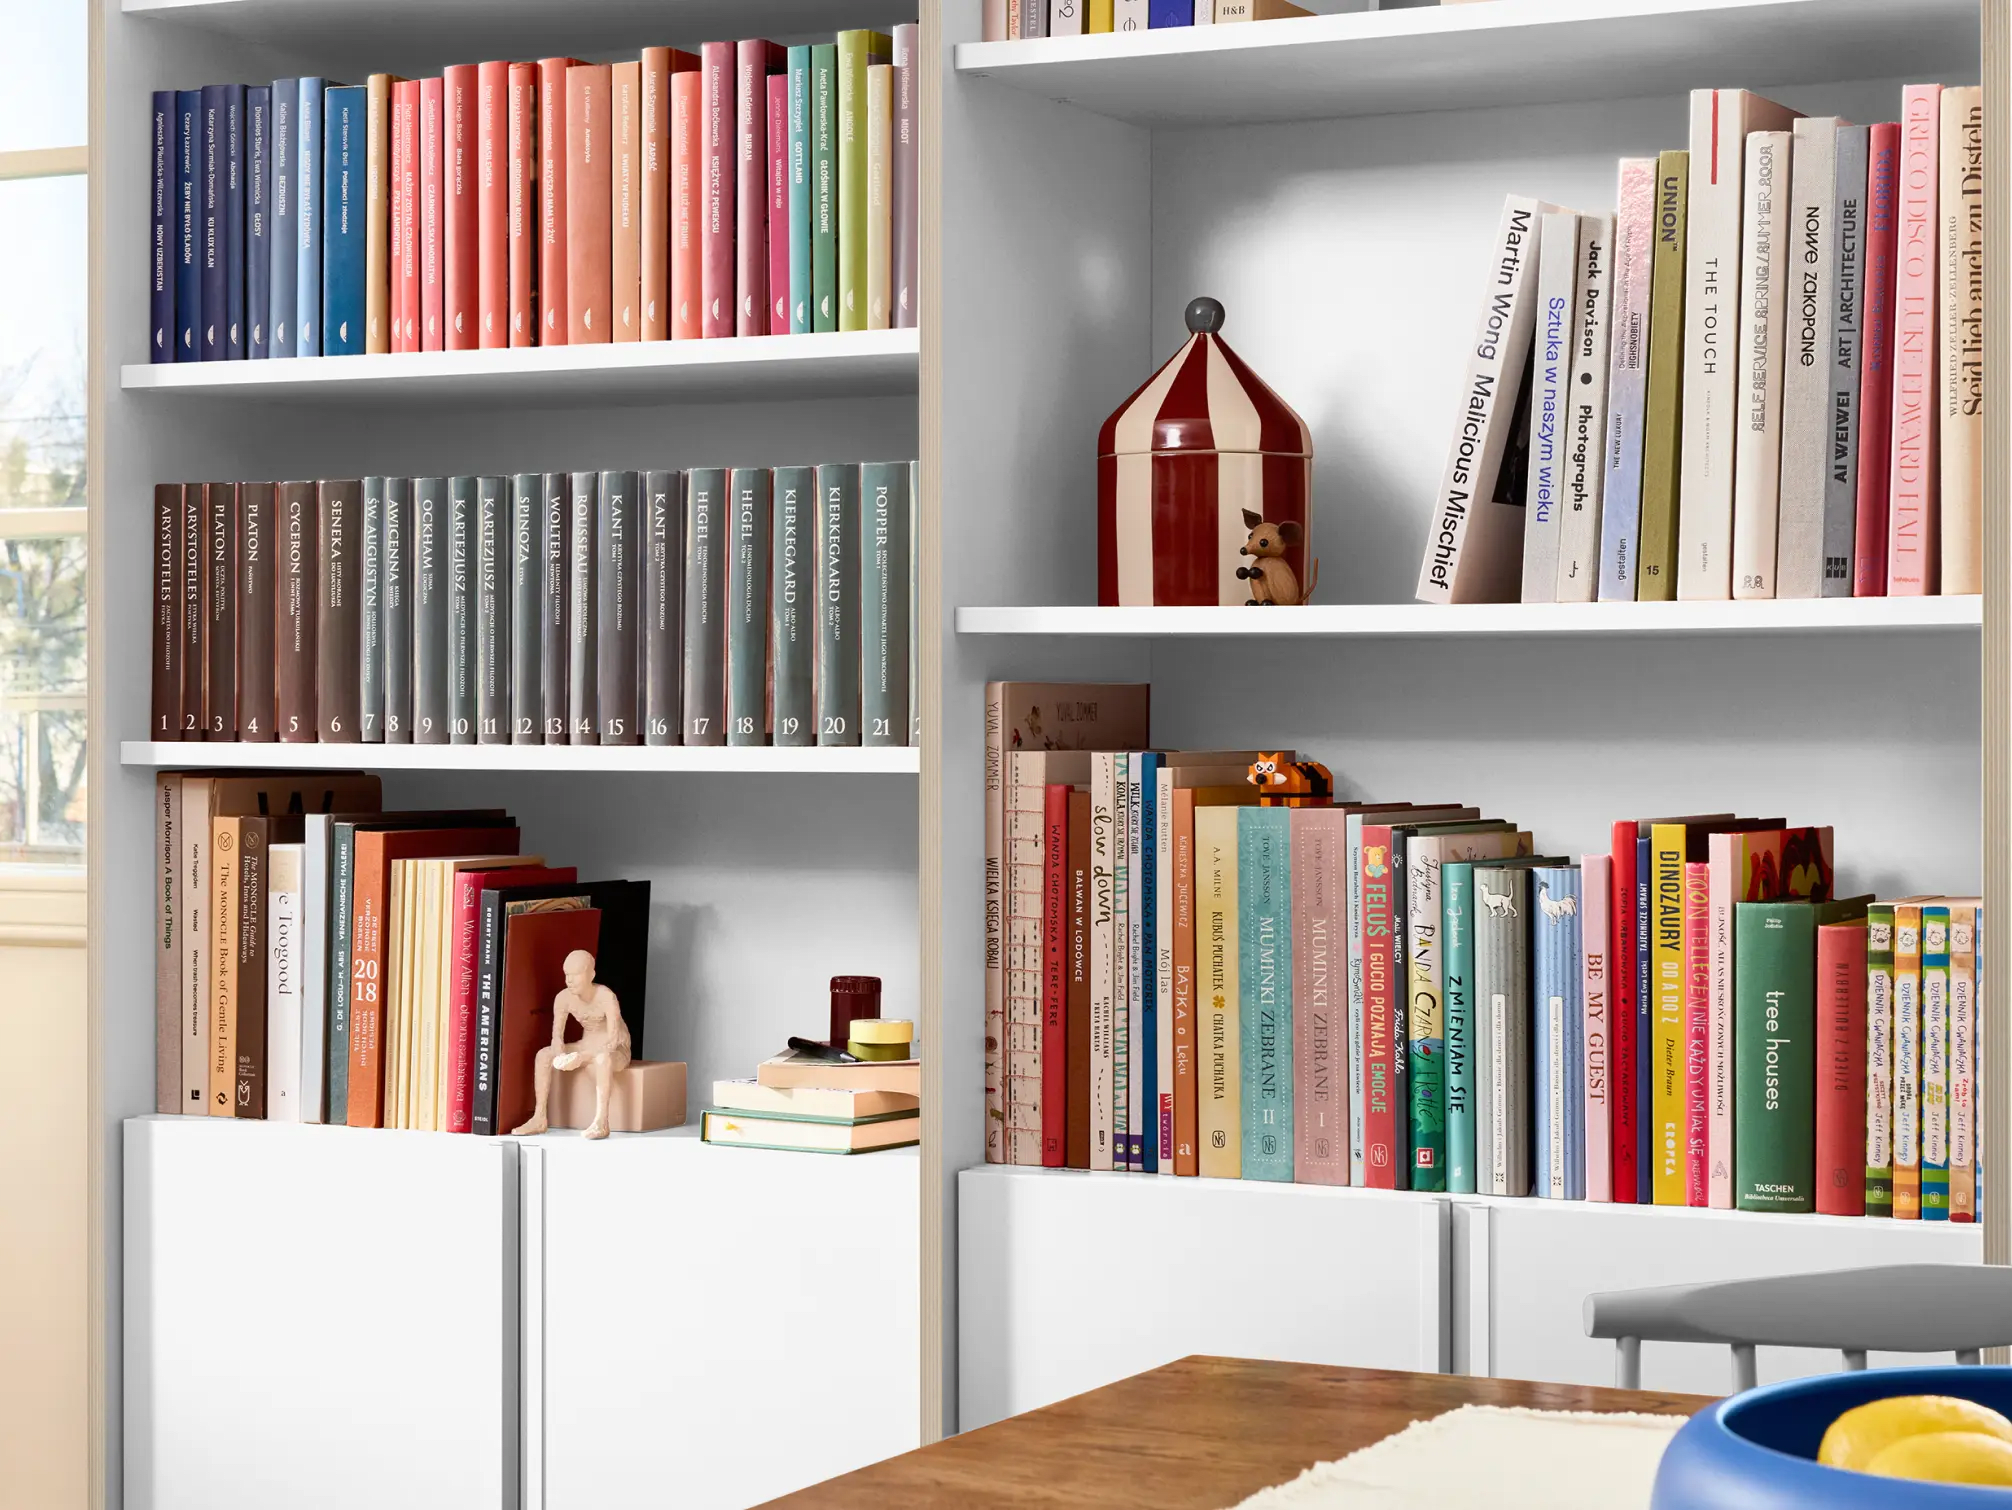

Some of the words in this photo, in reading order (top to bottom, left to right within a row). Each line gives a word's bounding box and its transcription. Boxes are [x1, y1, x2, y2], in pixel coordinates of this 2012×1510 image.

[1223, 5, 1246, 16] H&B
[1908, 98, 1929, 190] GRECO
[711, 156, 720, 188] KSIĘŻYC
[820, 160, 829, 193] GŁOŚNIK
[207, 217, 214, 227] KU
[820, 204, 828, 233] GŁOWIE
[1497, 209, 1532, 285] Martin
[1906, 199, 1926, 278] DISCO
[1587, 241, 1603, 279] Jack
[1705, 258, 1718, 296] THE
[1840, 200, 1858, 324] ARCHITECTURE
[1477, 294, 1514, 360] Wong
[1546, 297, 1565, 361] Sztuka
[1583, 289, 1599, 357] Davison
[1630, 312, 1640, 369] HIGHSNOBIETY
[1704, 304, 1717, 374] TOUCH
[1902, 296, 1925, 364] LUKE
[1839, 336, 1853, 368] ART
[1546, 367, 1557, 383] w
[1453, 373, 1494, 484] Malicious
[1538, 389, 1555, 461] naszym
[1836, 391, 1851, 459] WEIWEI
[1899, 372, 1922, 484] EDWARD
[1573, 405, 1592, 511] Photographs
[1835, 464, 1847, 483] AI
[1536, 467, 1555, 522] wieku
[215, 505, 225, 560] PLATON
[248, 504, 258, 561] PLATON
[331, 500, 341, 558] SENEKA
[520, 497, 529, 563] SPINOZA
[550, 496, 560, 560] WOLTER
[577, 495, 587, 573] ROUSSEAU
[612, 495, 621, 539] KANT
[655, 493, 665, 538] KANT
[698, 491, 708, 542] HEGEL
[742, 490, 752, 540] HEGEL
[876, 486, 887, 546] POPPER
[1897, 492, 1918, 562] HALL
[161, 506, 171, 600] ARYSTOTELES
[187, 505, 197, 600] ARYSTOTELES
[290, 502, 300, 573] CYCERON
[389, 500, 398, 581] AWICENNA
[422, 500, 432, 569] OCKHAM
[455, 499, 465, 591] KARTEZJUSZ
[483, 498, 494, 590] KARTEZJUSZ
[785, 489, 796, 603] KIERKEGAARD
[829, 487, 840, 601] KIERKEGAARD
[1429, 490, 1468, 589] Mischief
[366, 525, 377, 606] AUGUSTYN
[1647, 566, 1659, 575] 15
[161, 715, 167, 729] 1
[187, 715, 195, 729] 2
[215, 716, 222, 731] 3
[248, 718, 258, 733] 4
[290, 717, 298, 732] 5
[331, 716, 341, 732] 6
[365, 714, 374, 729] 7
[389, 716, 398, 731] 8
[422, 718, 431, 733] 9
[451, 719, 468, 735] 10
[482, 718, 497, 734] 11
[516, 718, 532, 733] 12
[546, 719, 562, 734] 13
[574, 718, 590, 733] 14
[608, 719, 624, 735] 15
[651, 719, 667, 735] 16
[693, 718, 709, 734] 17
[736, 717, 753, 733] 18
[782, 718, 798, 734] 19
[824, 717, 845, 734] 20
[873, 719, 890, 735] 21
[163, 785, 172, 817] Jasper
[165, 821, 173, 864] Morrison
[1094, 805, 1112, 855] slow
[220, 863, 229, 887] The
[250, 856, 258, 870] The
[986, 857, 999, 892] WIELKA
[165, 877, 173, 902] Book
[1075, 870, 1084, 913] BAŁWAN
[1094, 866, 1112, 927] down
[1660, 851, 1680, 950] DINOZAURY
[165, 905, 173, 914] of
[985, 900, 999, 934] KSIĘGA
[1075, 917, 1083, 926] W
[1213, 912, 1226, 942] KUBUŚ
[1367, 884, 1391, 936] FELUŚ
[163, 917, 173, 948] Things
[459, 920, 474, 964] Woody
[219, 948, 228, 980] Book
[250, 948, 256, 956] to
[274, 914, 292, 994] Toogood
[355, 959, 377, 979] 20
[1075, 930, 1085, 982] LODÓWCE
[1158, 948, 1171, 973] Mój
[1212, 945, 1224, 990] PUCHATEK
[1260, 916, 1275, 1004] MUMINKI
[1588, 953, 1602, 980] BE
[219, 984, 229, 992] of
[460, 966, 475, 995] Allen
[482, 974, 491, 999] THE
[1161, 977, 1171, 994] las
[1370, 953, 1384, 991] GUCIO
[355, 982, 376, 1002] 18
[1589, 992, 1602, 1023] MY
[1766, 991, 1784, 1031] tree
[218, 995, 228, 1031] Gentle
[1213, 1013, 1225, 1049] CHATKA
[1368, 997, 1386, 1057] POZNAJĄ
[216, 1036, 227, 1073] Living
[479, 1005, 490, 1091] AMERICANS
[1260, 1011, 1274, 1099] ZEBRANE
[1213, 1053, 1224, 1099] PUCHATKA
[1372, 1063, 1386, 1112] EMOCJE
[1589, 1033, 1604, 1104] GUEST
[1765, 1039, 1791, 1110] houses
[1956, 1111, 1966, 1131] Jeff
[1955, 1135, 1966, 1162] Kinney
[1755, 1184, 1794, 1193] TASCHEN
